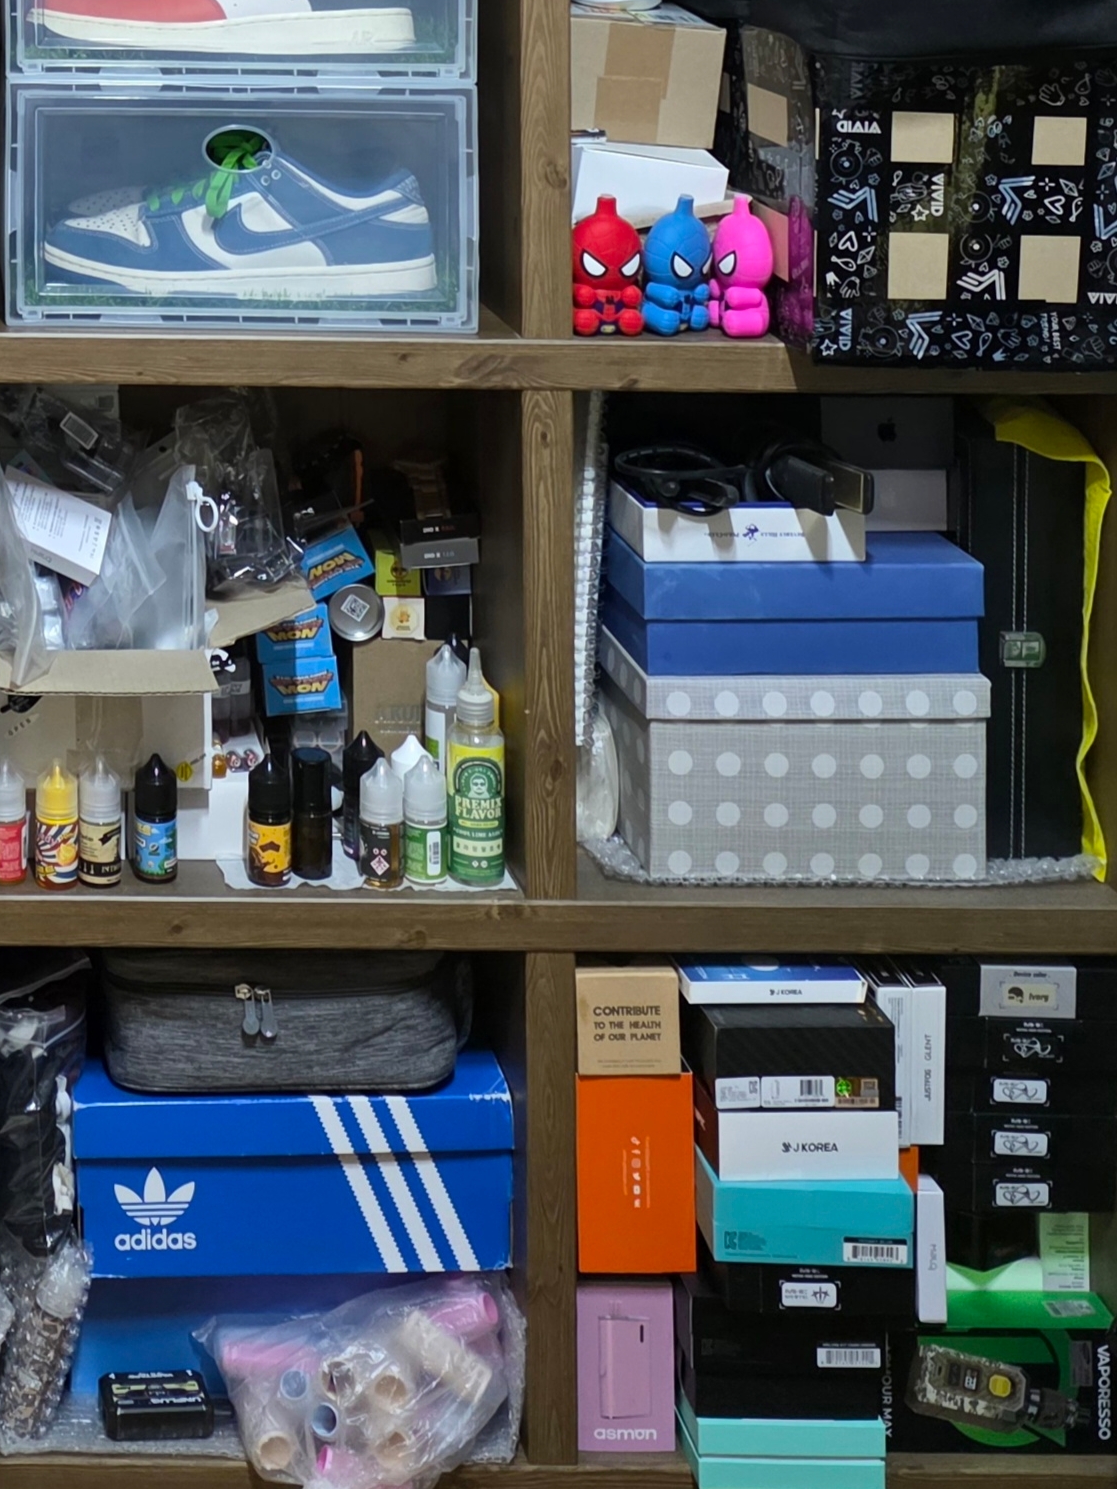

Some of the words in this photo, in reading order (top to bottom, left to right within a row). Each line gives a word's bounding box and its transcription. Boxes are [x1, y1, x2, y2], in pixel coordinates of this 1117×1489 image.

[837, 121, 882, 134] VIVID
[930, 173, 944, 217] VIVID
[839, 308, 852, 351] VIVID
[267, 627, 317, 642] MON
[277, 680, 326, 695] MON
[8, 717, 32, 736] OPEN
[455, 795, 502, 810] PREMIX
[455, 807, 502, 820] FLAVOR
[1028, 993, 1049, 1003] Ivory
[593, 1005, 661, 1016] CONTRIBUTE
[593, 1021, 605, 1030] TO
[609, 1021, 624, 1029] THE
[629, 1021, 661, 1029] HEALTH
[593, 1033, 605, 1042] OF
[608, 1033, 626, 1041] OUR
[630, 1033, 661, 1041] PLANET
[924, 1033, 932, 1061] GLENT
[924, 1069, 932, 1102] JUSTFOG
[801, 1142, 838, 1152] KOREA
[114, 1228, 197, 1251] adidas
[1097, 1344, 1112, 1440] VAPORESSO
